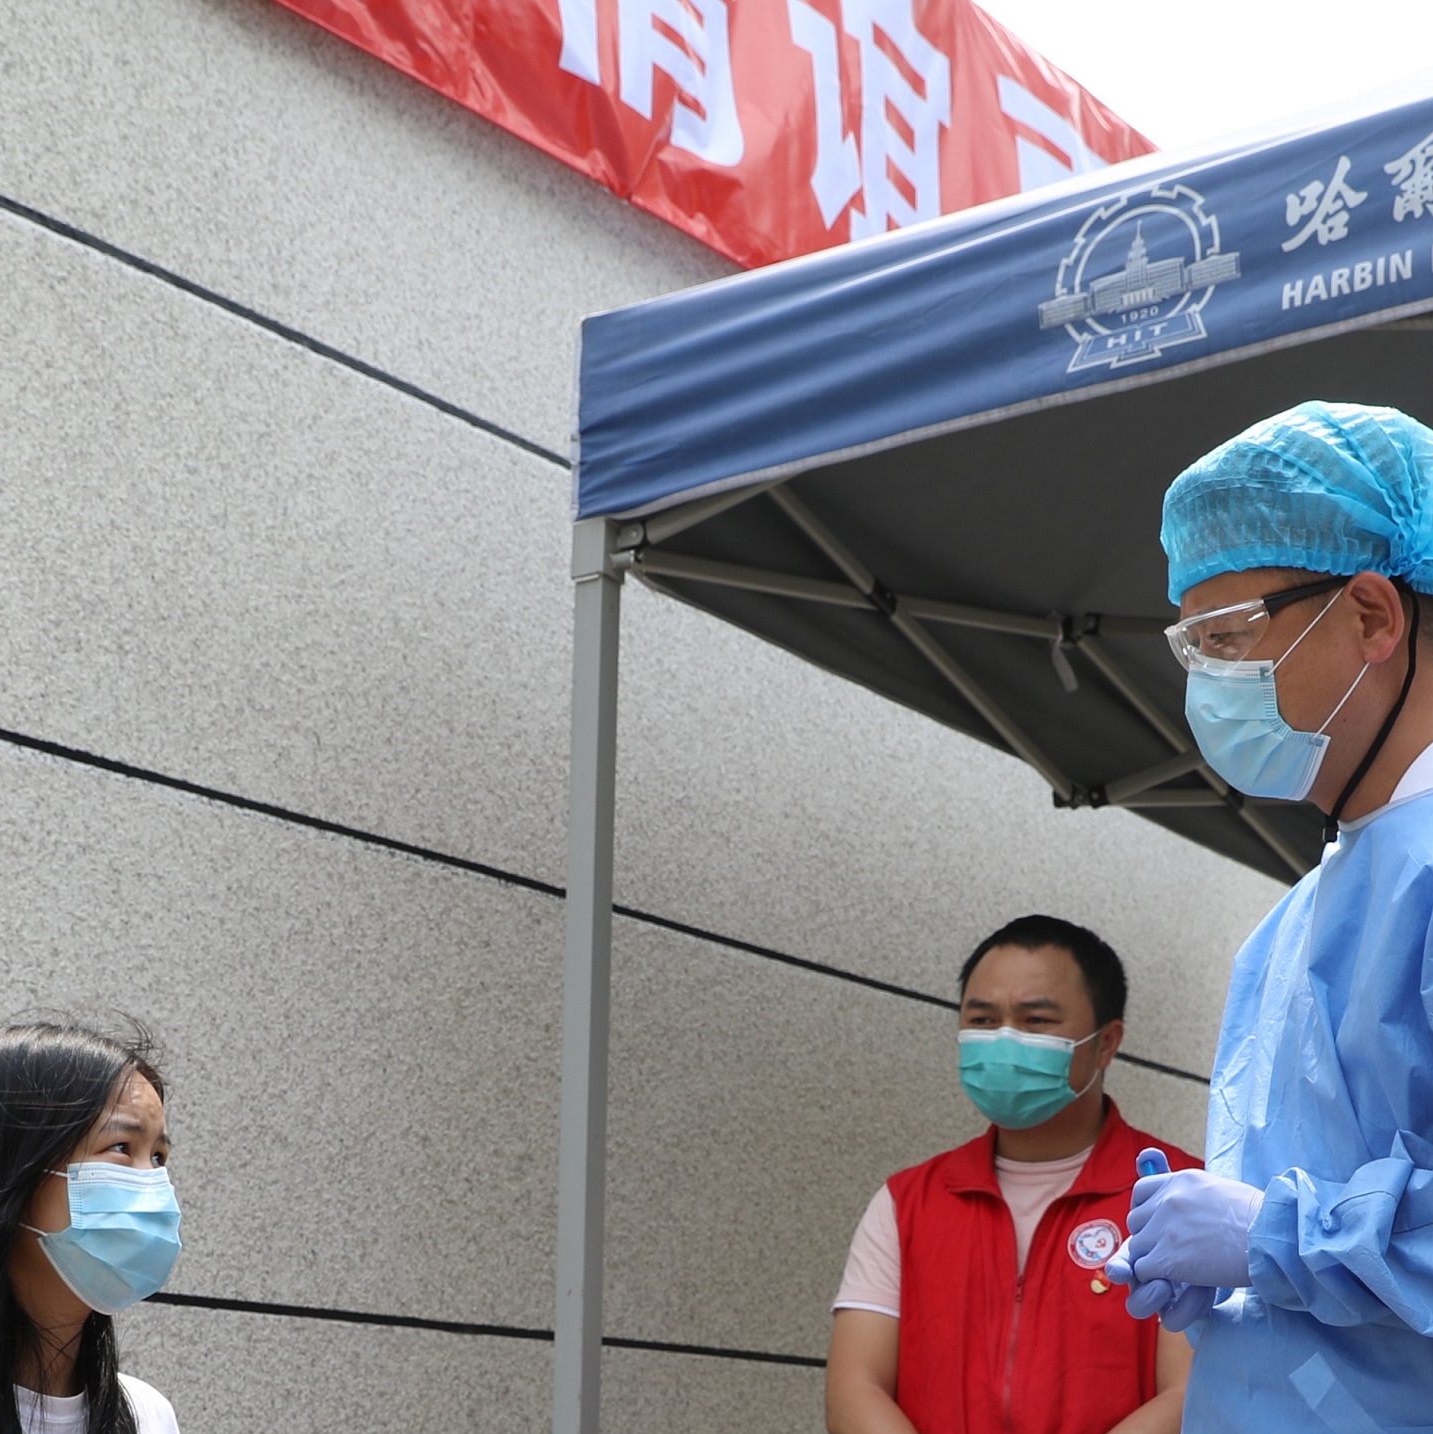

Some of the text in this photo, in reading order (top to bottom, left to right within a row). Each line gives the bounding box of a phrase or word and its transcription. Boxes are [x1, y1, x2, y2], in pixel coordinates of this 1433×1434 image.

[1282, 250, 1413, 310] HARBIN
[1122, 305, 1159, 324] 1920
[1107, 322, 1168, 349] HIT
